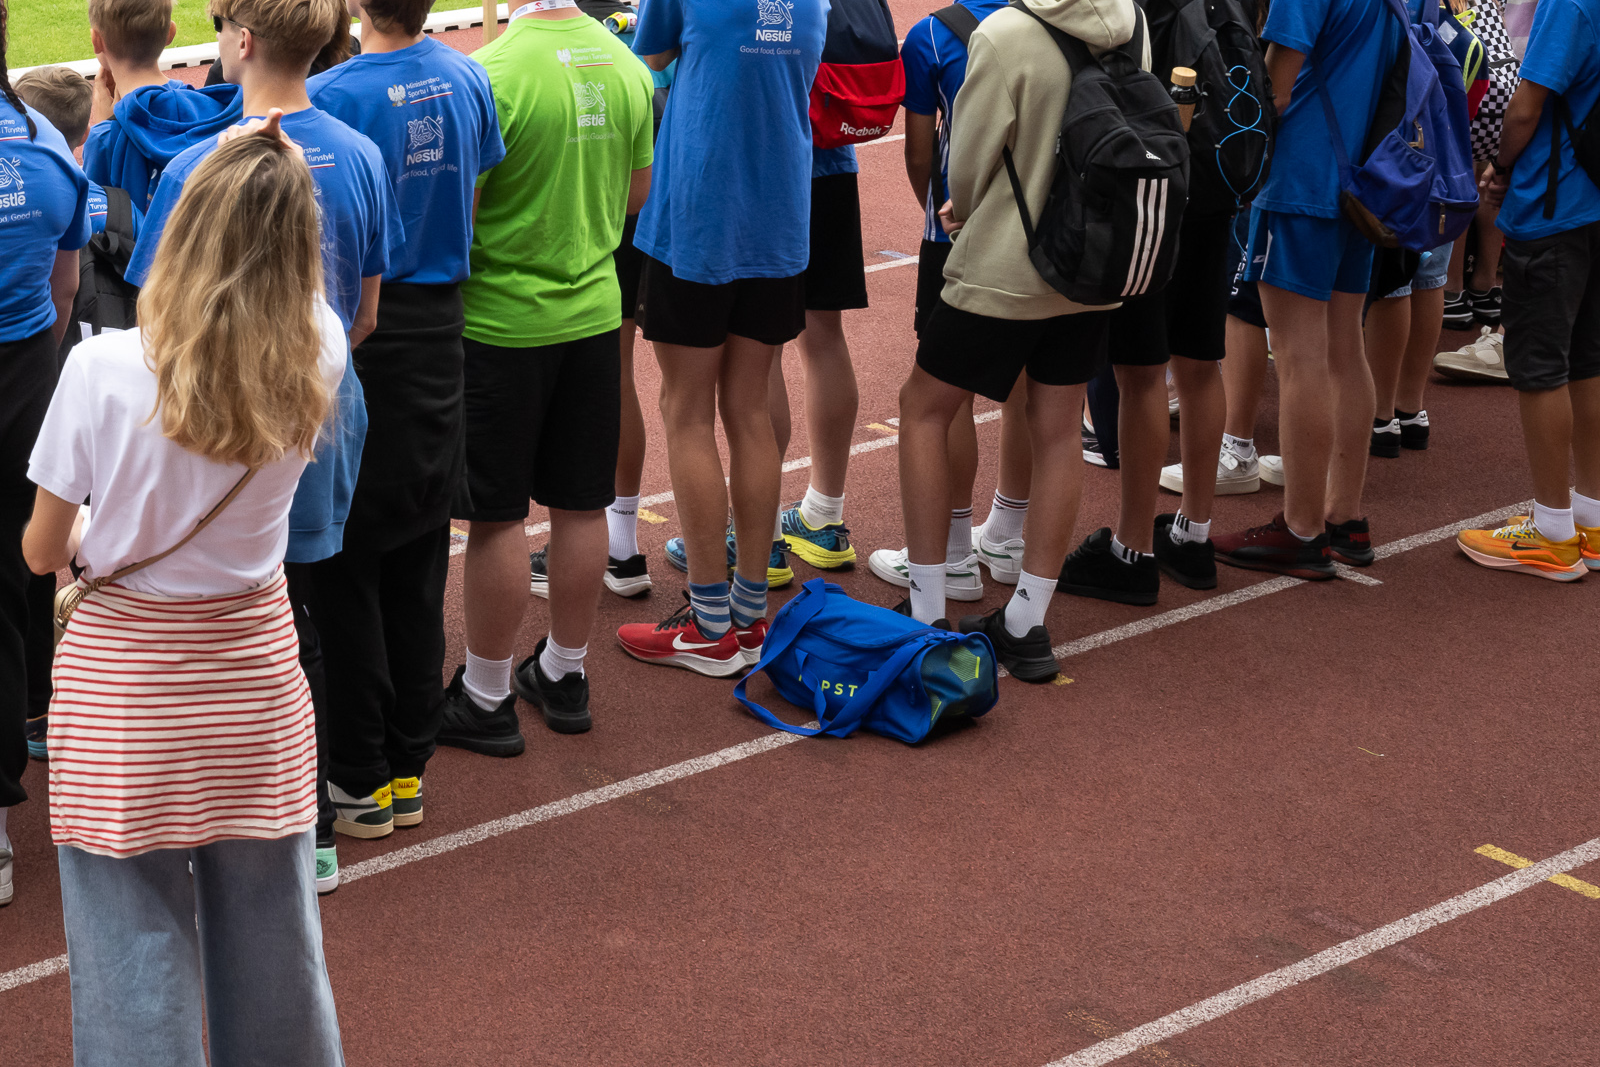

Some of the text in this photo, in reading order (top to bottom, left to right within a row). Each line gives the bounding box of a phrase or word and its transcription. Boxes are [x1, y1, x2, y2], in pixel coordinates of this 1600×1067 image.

[756, 29, 792, 42] Nestlé
[740, 45, 759, 54] Good
[760, 45, 775, 56] food,
[840, 121, 882, 136] Reebok
[407, 147, 443, 166] Nestlé
[11, 212, 30, 223] Good
[32, 210, 42, 219] life
